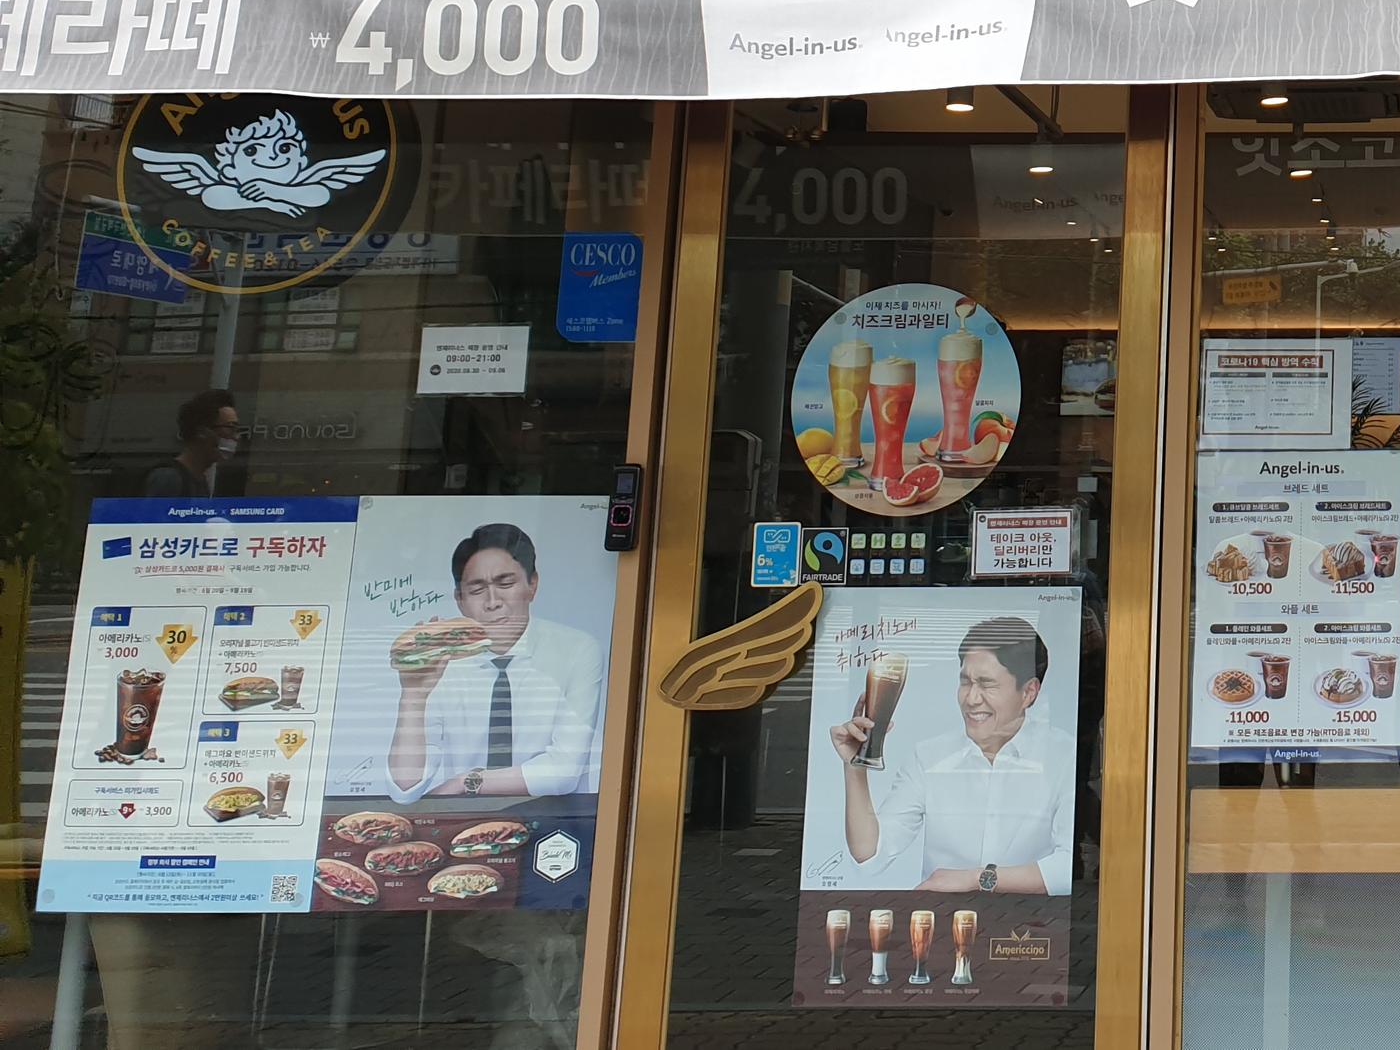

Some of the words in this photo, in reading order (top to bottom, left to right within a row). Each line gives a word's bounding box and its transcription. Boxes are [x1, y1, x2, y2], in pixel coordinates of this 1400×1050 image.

[162, 219, 256, 268] COFFEE
[283, 226, 333, 259] TEA
[570, 242, 636, 267] CESCO
[589, 267, 638, 288] Members
[912, 300, 942, 310] 마시자!
[851, 314, 949, 329] 치즈크림과일티
[1220, 357, 1258, 367] 코로나19
[1261, 357, 1279, 367] 핵심
[1281, 357, 1299, 367] 방역
[1282, 484, 1310, 493] 브레드
[1312, 483, 1329, 493] 세트
[230, 507, 265, 516] SAMSUNG
[266, 507, 285, 516] CARD
[990, 533, 1025, 544] 테이크
[138, 537, 239, 559] 삼성카드로
[246, 536, 326, 558] 구독하자
[994, 544, 1052, 556] 딜리버리만
[993, 556, 1053, 569] 가능합니다
[802, 573, 843, 582] FAIRTRADE
[363, 572, 413, 600] 반미에
[389, 588, 445, 618] 반하다
[1280, 604, 1299, 615] 와플
[1301, 604, 1320, 615] 세트
[298, 614, 313, 625] 33
[833, 616, 918, 644] 아메리치노에
[167, 631, 187, 644] 30
[835, 649, 889, 673] 취하다
[1236, 728, 1251, 737] 모든
[1253, 728, 1288, 737] 제조음료로
[1290, 728, 1305, 737] 변경
[1306, 727, 1351, 737] 가능(RTD음료
[1353, 727, 1370, 737] 제외)
[284, 733, 298, 745] 33
[995, 941, 1045, 958] Americcino
